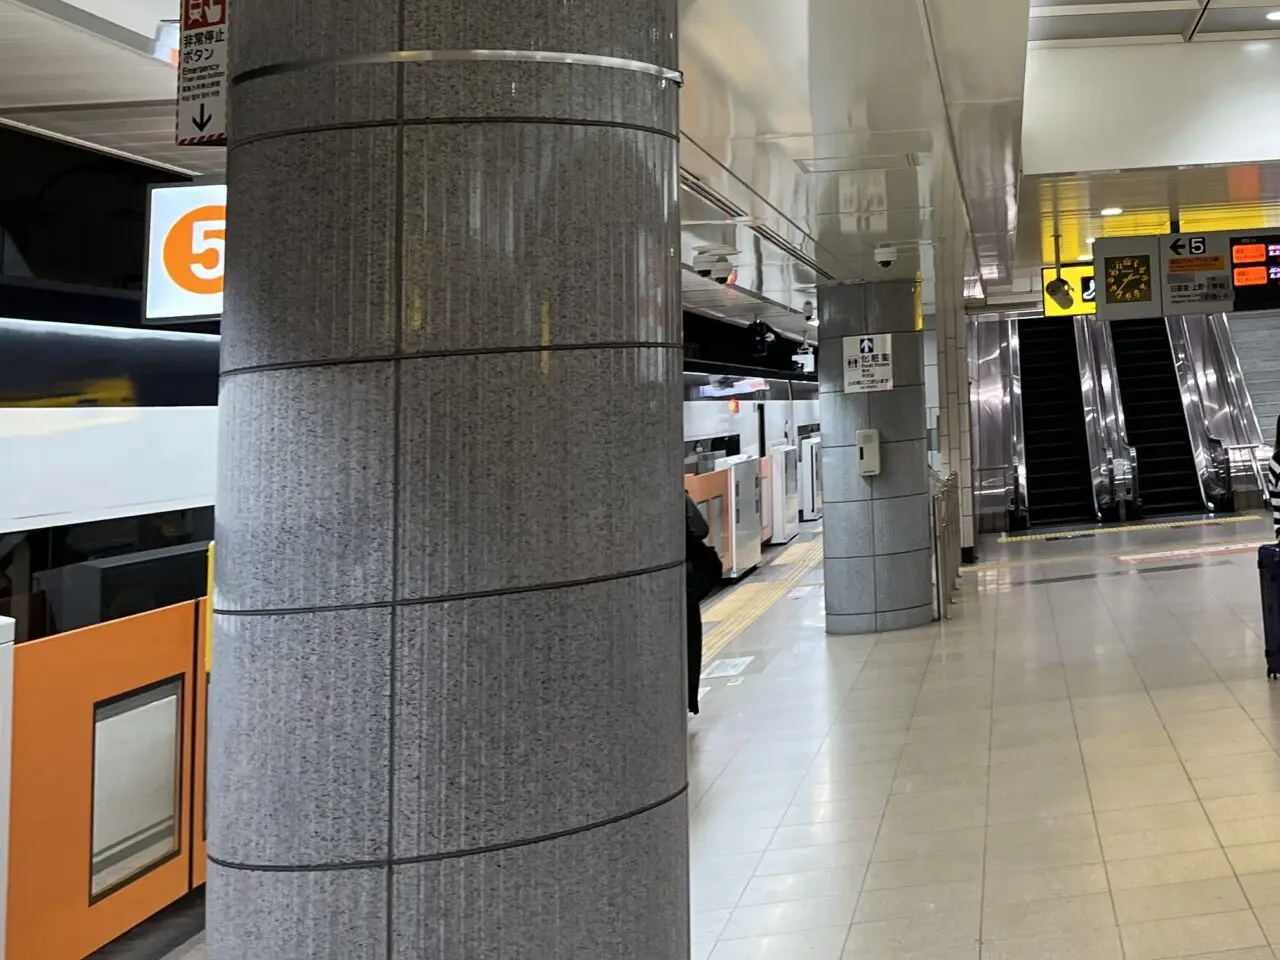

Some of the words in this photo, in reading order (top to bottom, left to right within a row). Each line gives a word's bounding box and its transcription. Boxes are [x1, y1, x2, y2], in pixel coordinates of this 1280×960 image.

[183, 29, 225, 49] 非常停止
[183, 48, 214, 64] ボタン
[182, 63, 220, 76] Emergency
[190, 219, 227, 280] 5
[1191, 238, 1204, 254] 5
